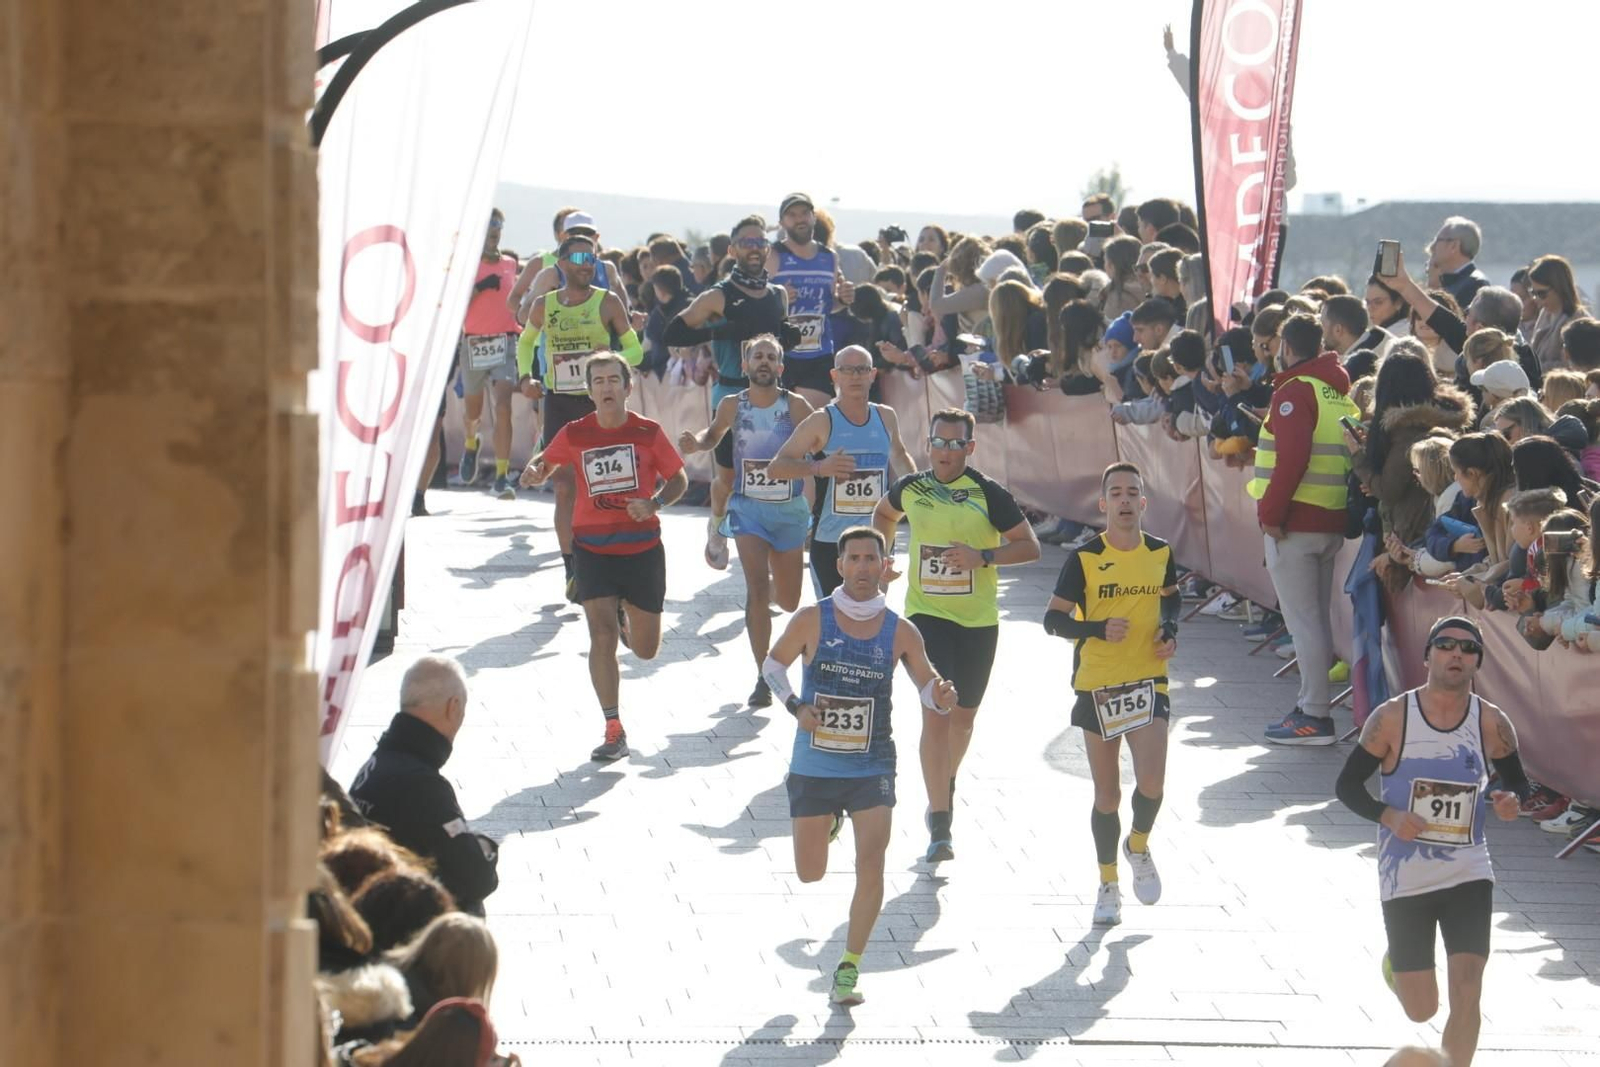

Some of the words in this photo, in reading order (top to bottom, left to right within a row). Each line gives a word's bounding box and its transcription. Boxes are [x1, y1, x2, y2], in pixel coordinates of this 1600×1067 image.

[799, 325, 816, 336] 67
[594, 459, 623, 476] 314
[846, 483, 873, 497] 816
[820, 663, 848, 675] PAZITO
[855, 668, 884, 680] PAZITO
[1103, 694, 1147, 717] 1756
[1431, 798, 1461, 820] 911
